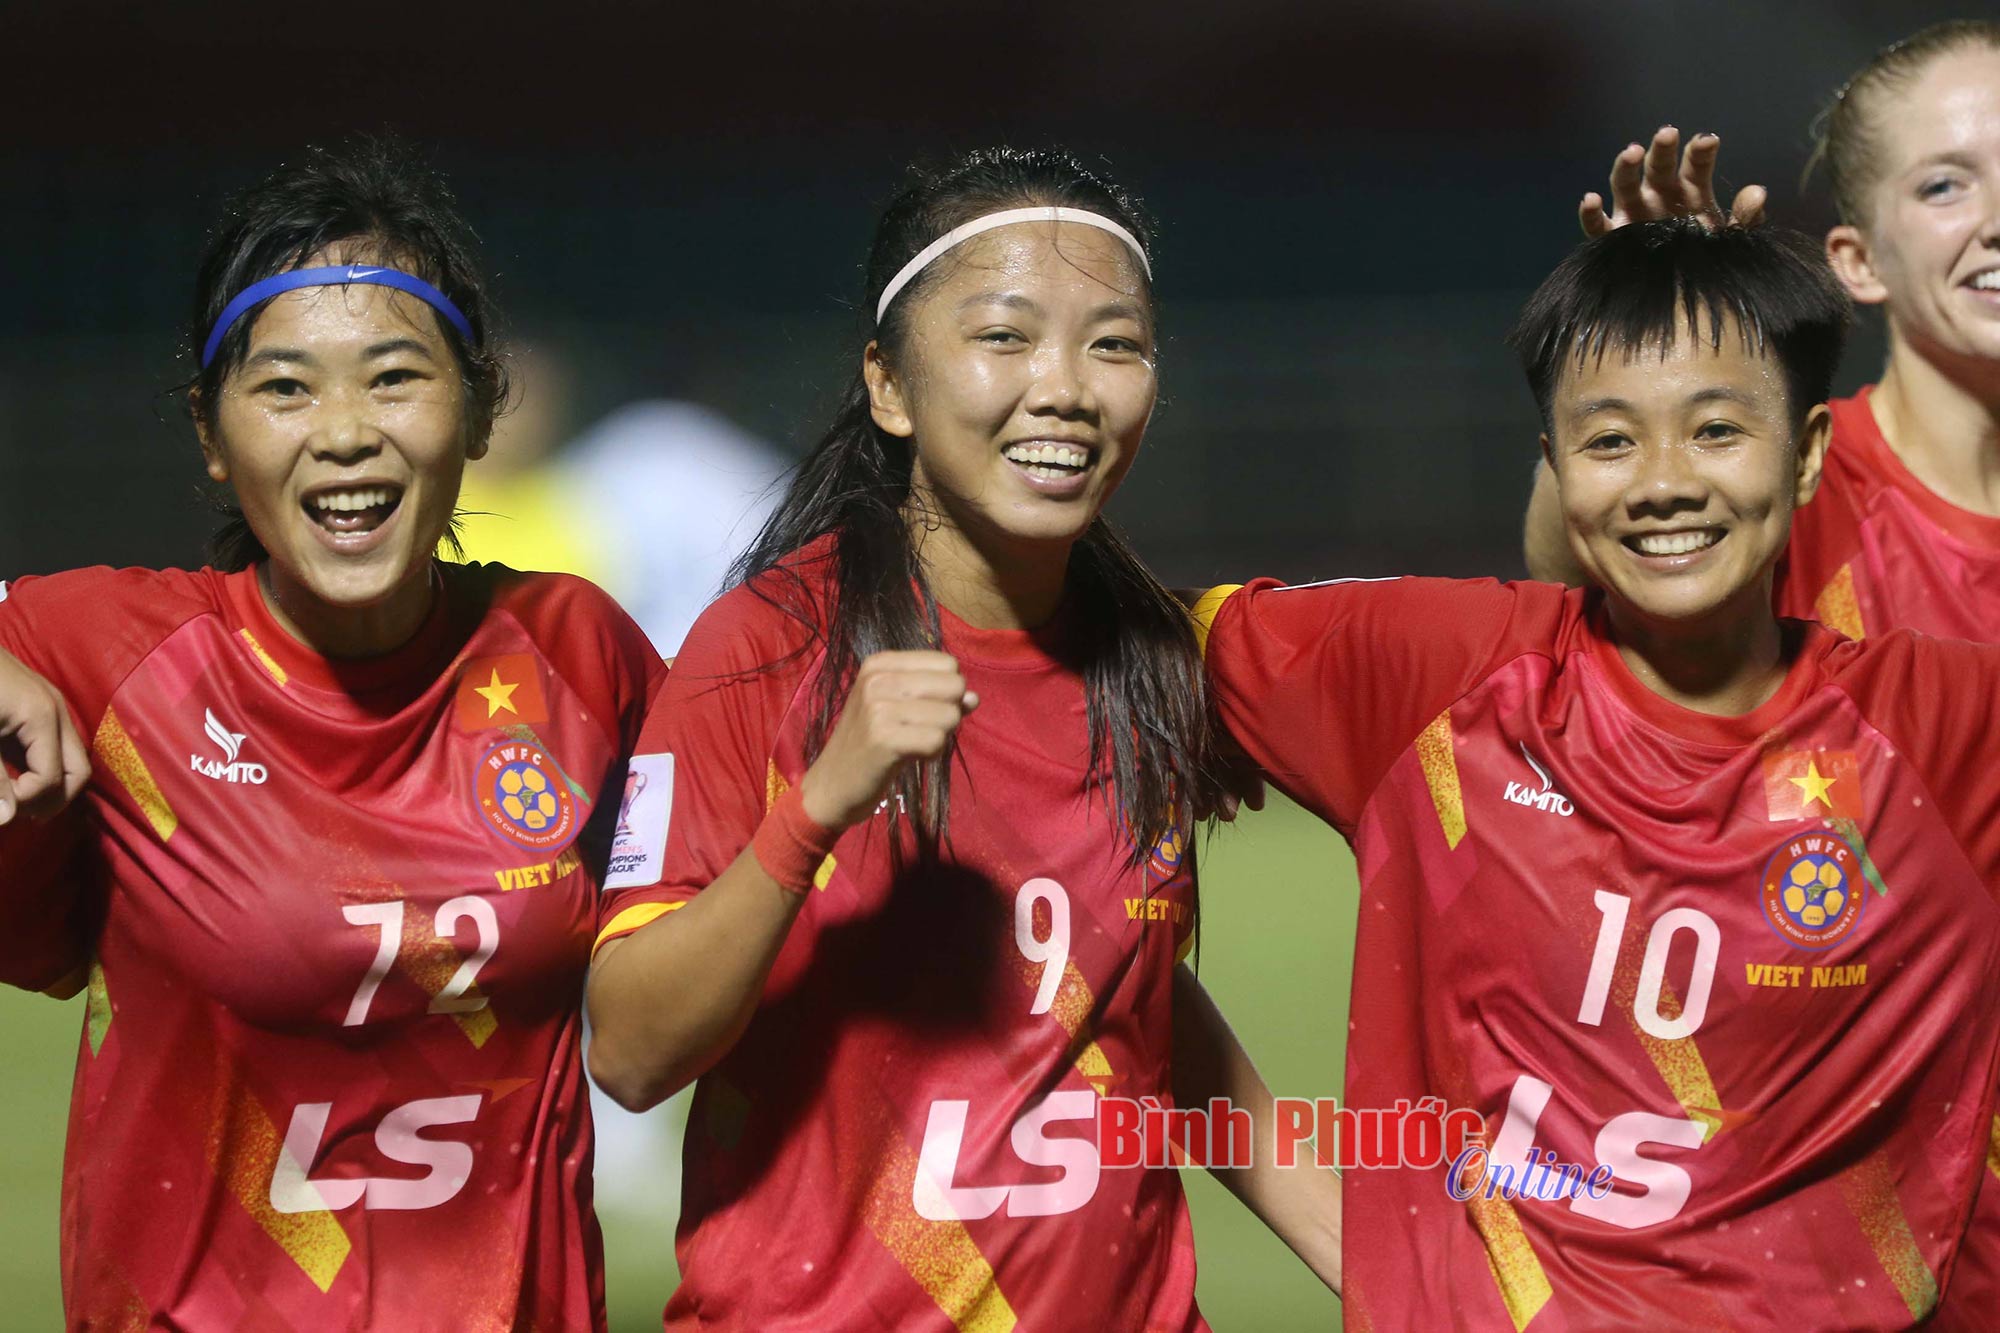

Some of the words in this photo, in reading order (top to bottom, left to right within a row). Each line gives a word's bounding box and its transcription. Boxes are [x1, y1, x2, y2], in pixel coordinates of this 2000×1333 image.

[190, 753, 268, 785] KAMITO
[488, 747, 542, 771] HWFC
[1503, 780, 1575, 817] KAMITO
[494, 862, 551, 892] VIET
[1789, 838, 1848, 862] HWFC
[341, 894, 500, 1027] 72
[1014, 877, 1071, 1015] 9
[1577, 888, 1722, 1040] 10
[1745, 963, 1805, 988] VIET
[1810, 963, 1868, 988] NAM
[269, 1093, 483, 1214] LS
[913, 1090, 1100, 1220] LS
[1488, 1075, 1709, 1229] LS
